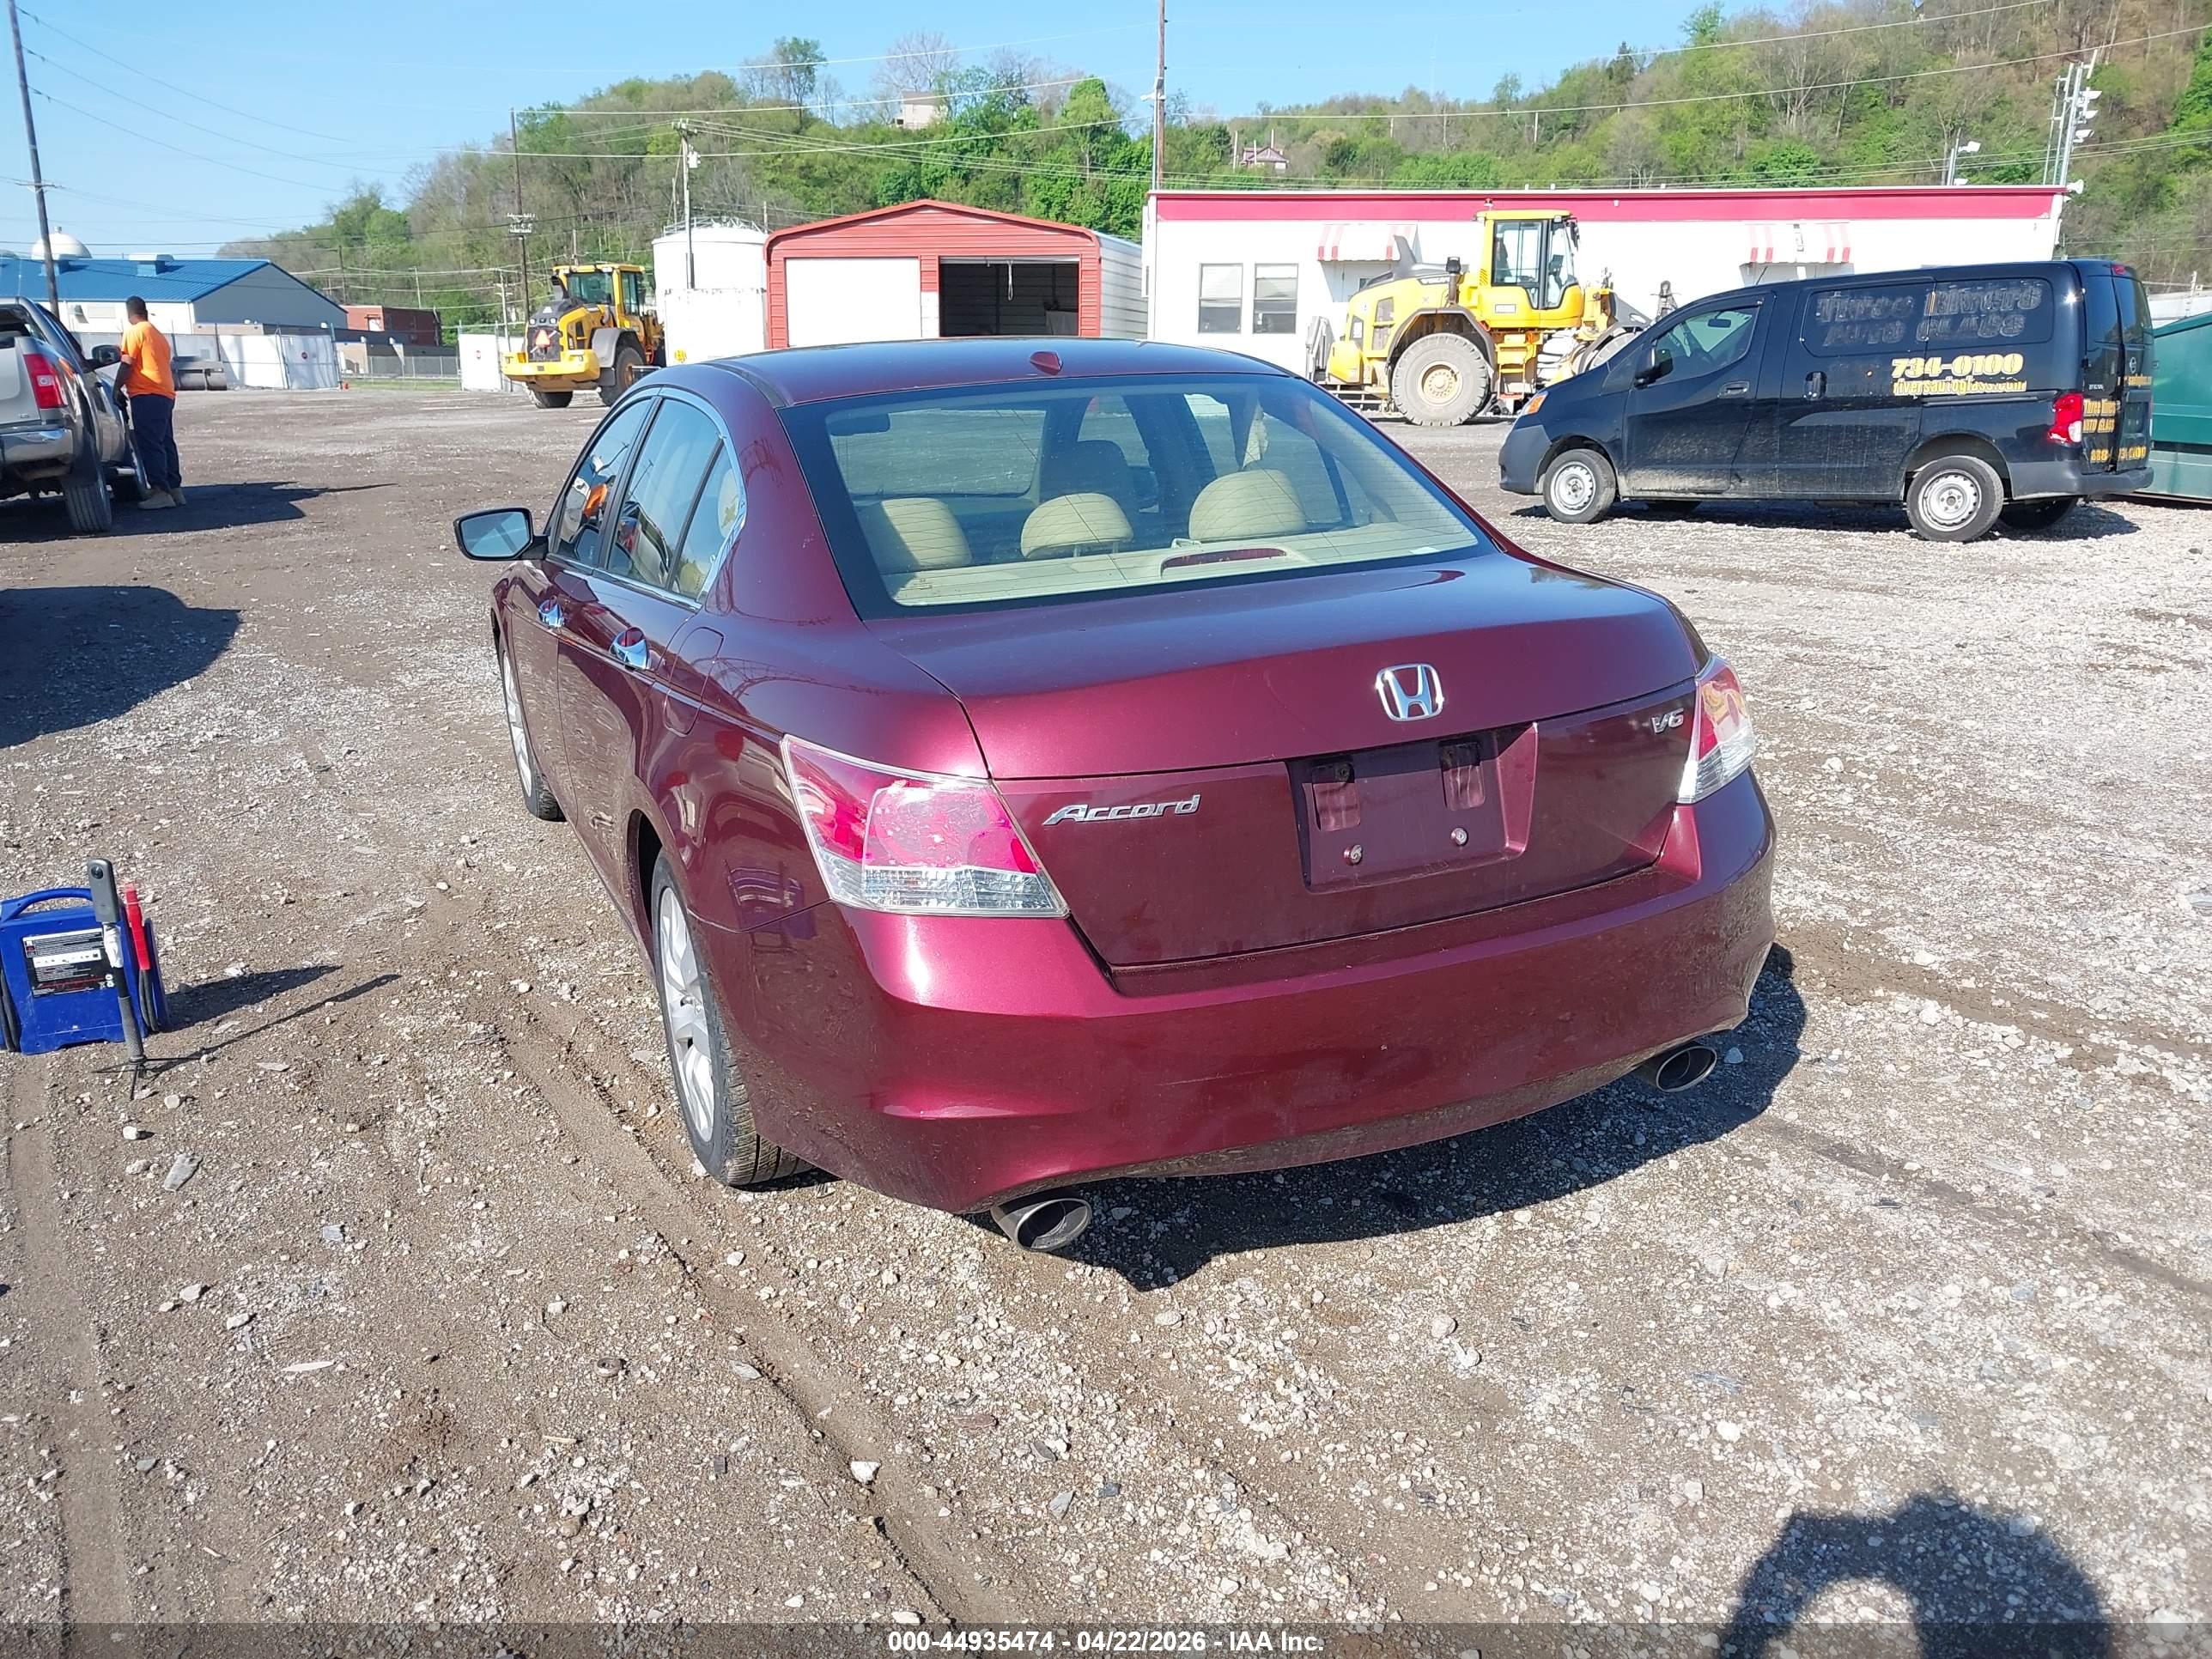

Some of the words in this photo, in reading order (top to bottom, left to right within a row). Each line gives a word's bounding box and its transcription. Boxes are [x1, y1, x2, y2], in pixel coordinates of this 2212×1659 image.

[1891, 353, 2024, 379] 734-0100
[1651, 708, 1684, 733] V6
[1042, 794, 1201, 825] Accord
